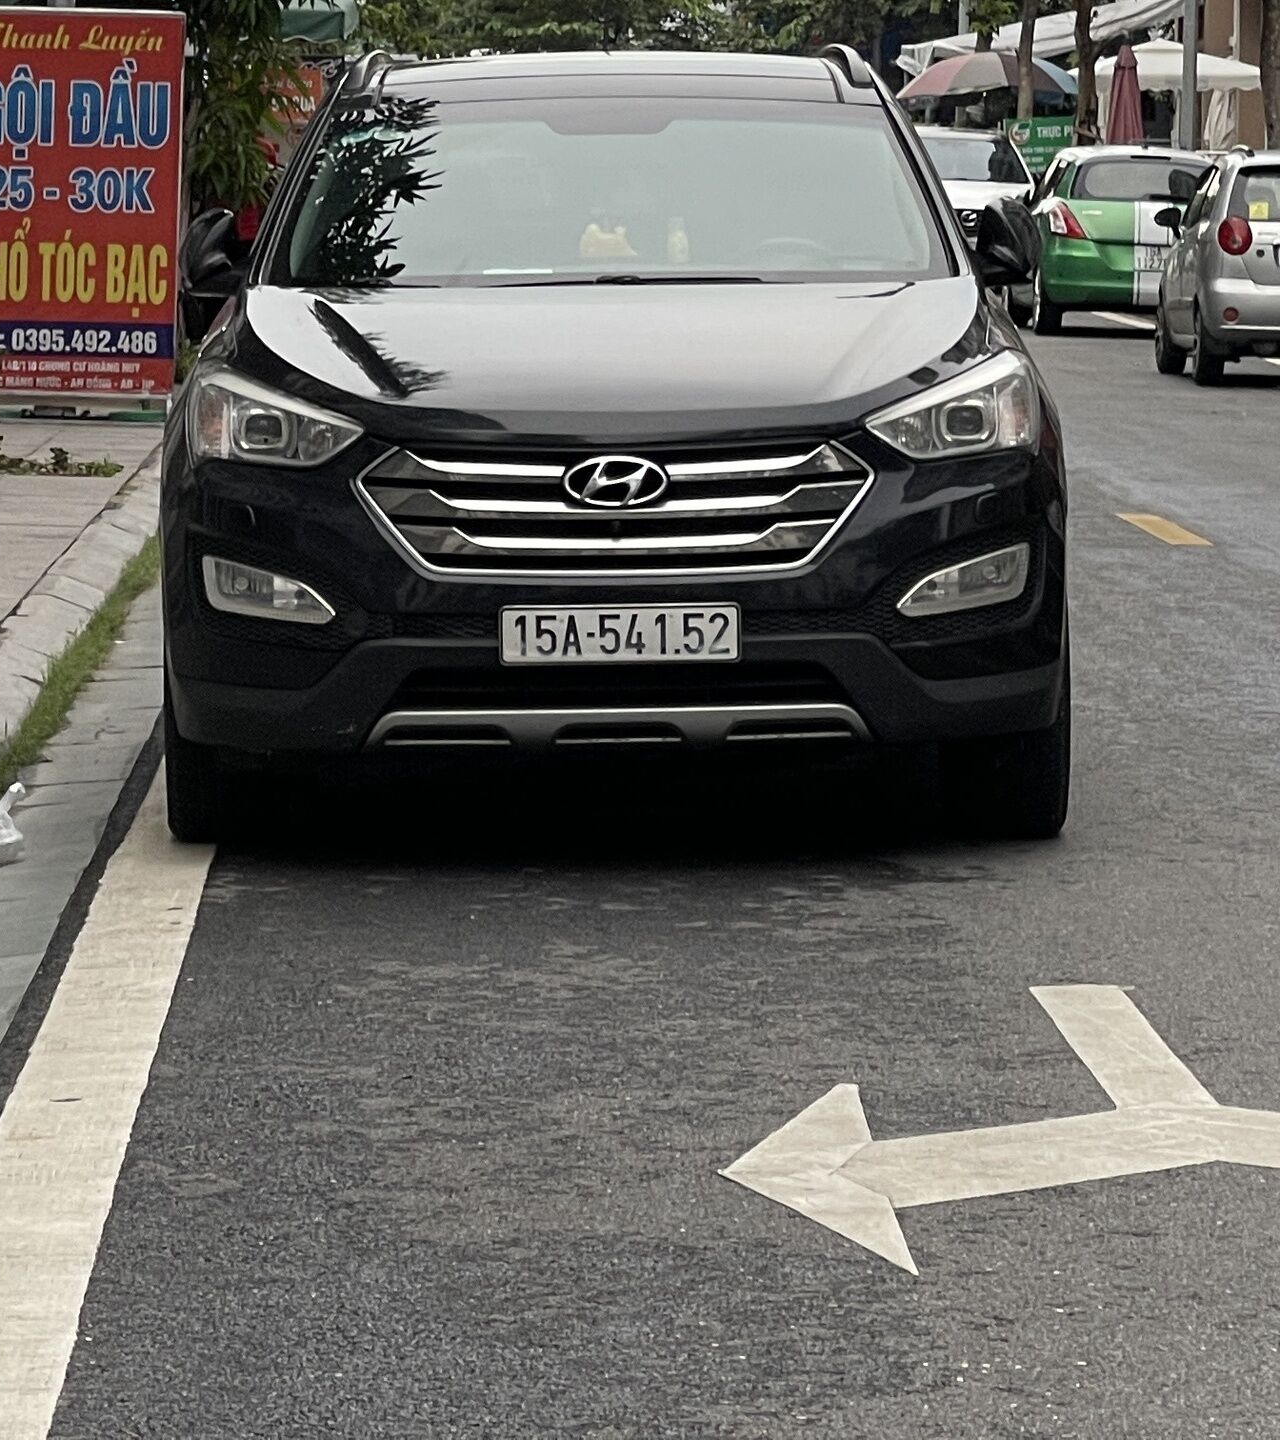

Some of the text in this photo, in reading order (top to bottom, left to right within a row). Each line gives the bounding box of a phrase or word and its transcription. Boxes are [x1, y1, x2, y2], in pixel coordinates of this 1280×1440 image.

[68, 58, 171, 150] ĐẦU
[68, 167, 155, 213] 30K
[39, 229, 97, 304] TÓC
[106, 244, 168, 318] BẠC
[11, 328, 157, 354] 0395.492.486
[515, 612, 731, 657] 15A-541.52
